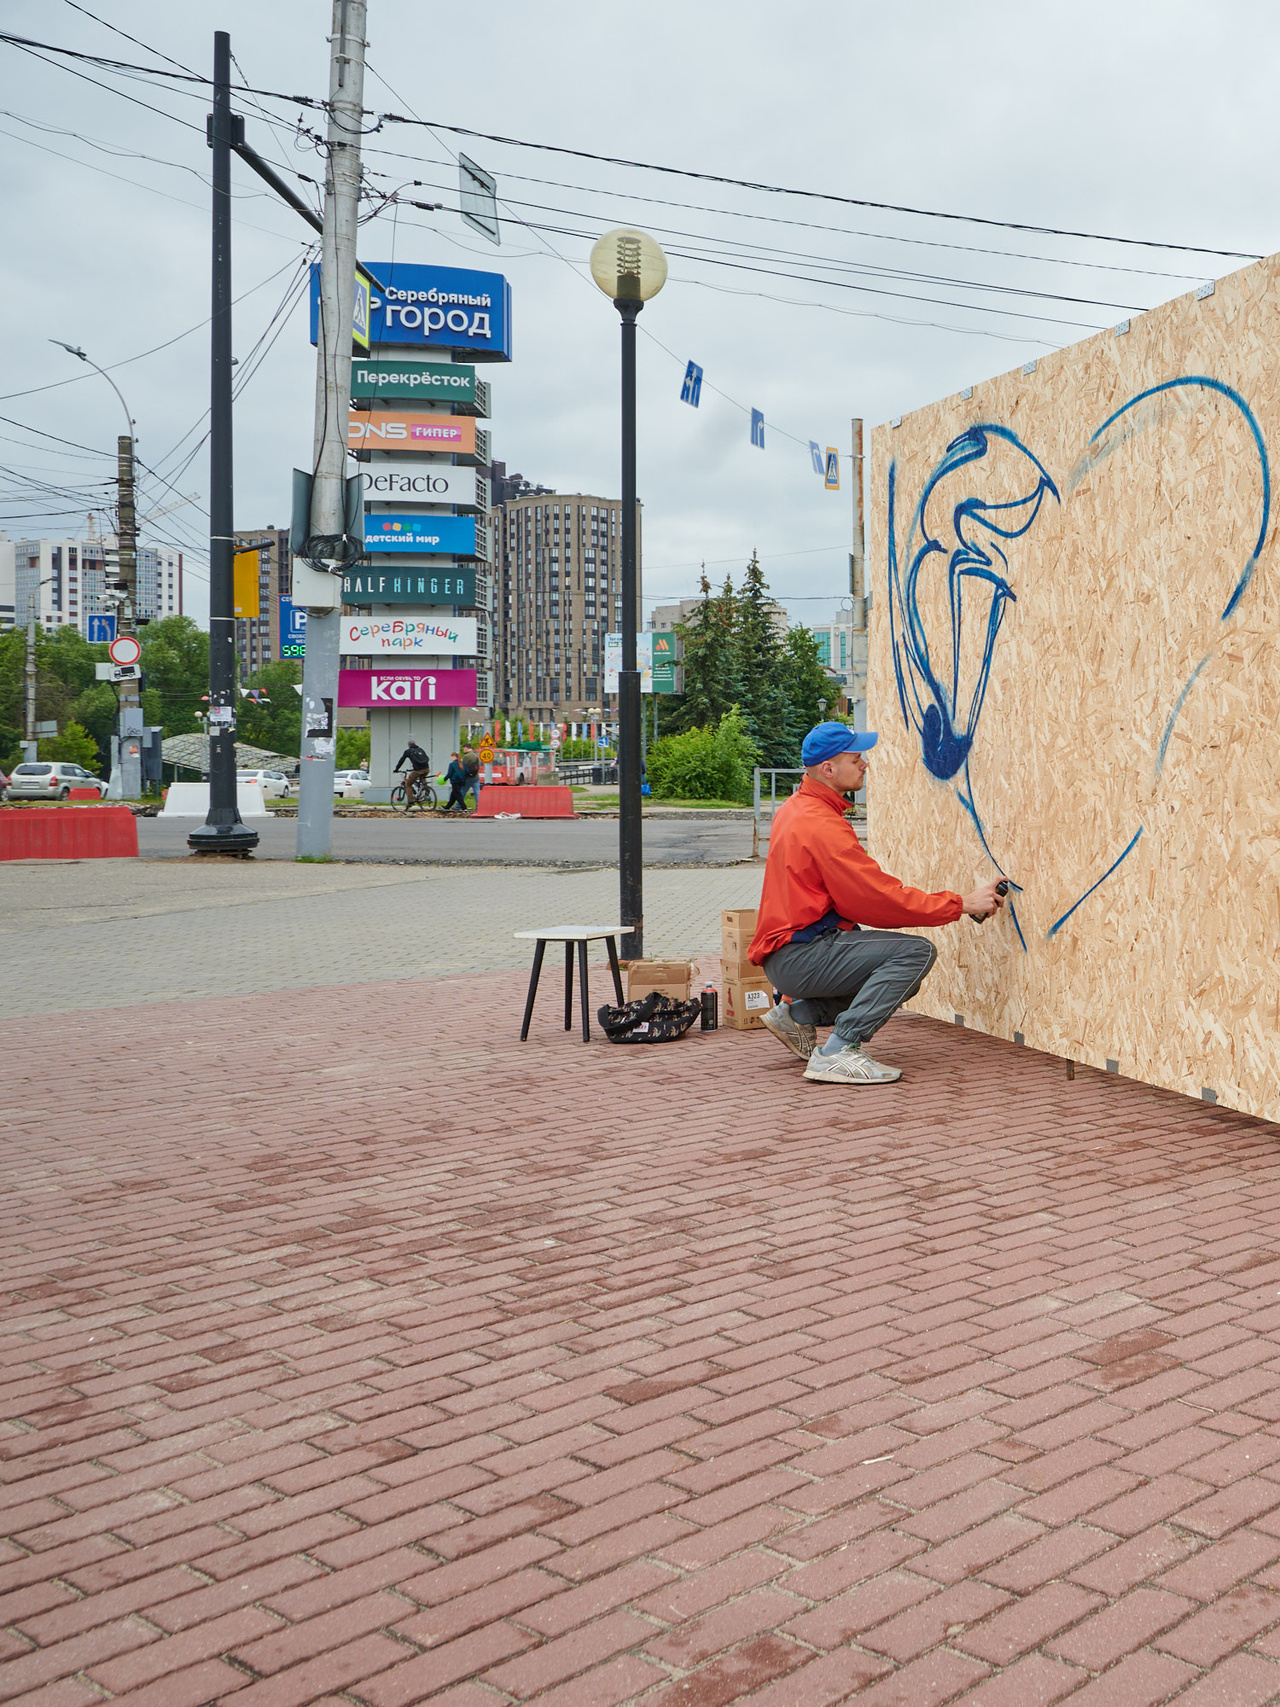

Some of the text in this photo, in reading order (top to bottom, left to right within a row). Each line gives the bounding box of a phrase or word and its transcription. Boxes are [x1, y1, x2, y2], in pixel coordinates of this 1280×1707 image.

[385, 286, 491, 307] Серебряный
[385, 305, 492, 339] город
[357, 370, 471, 388] Перекрёсток
[348, 422, 407, 439] DNS
[416, 427, 457, 438] ГИПЕР
[365, 533, 440, 546] детский мир
[343, 577, 386, 593] RALF
[381, 637, 424, 650] парк
[371, 676, 437, 700] kari
